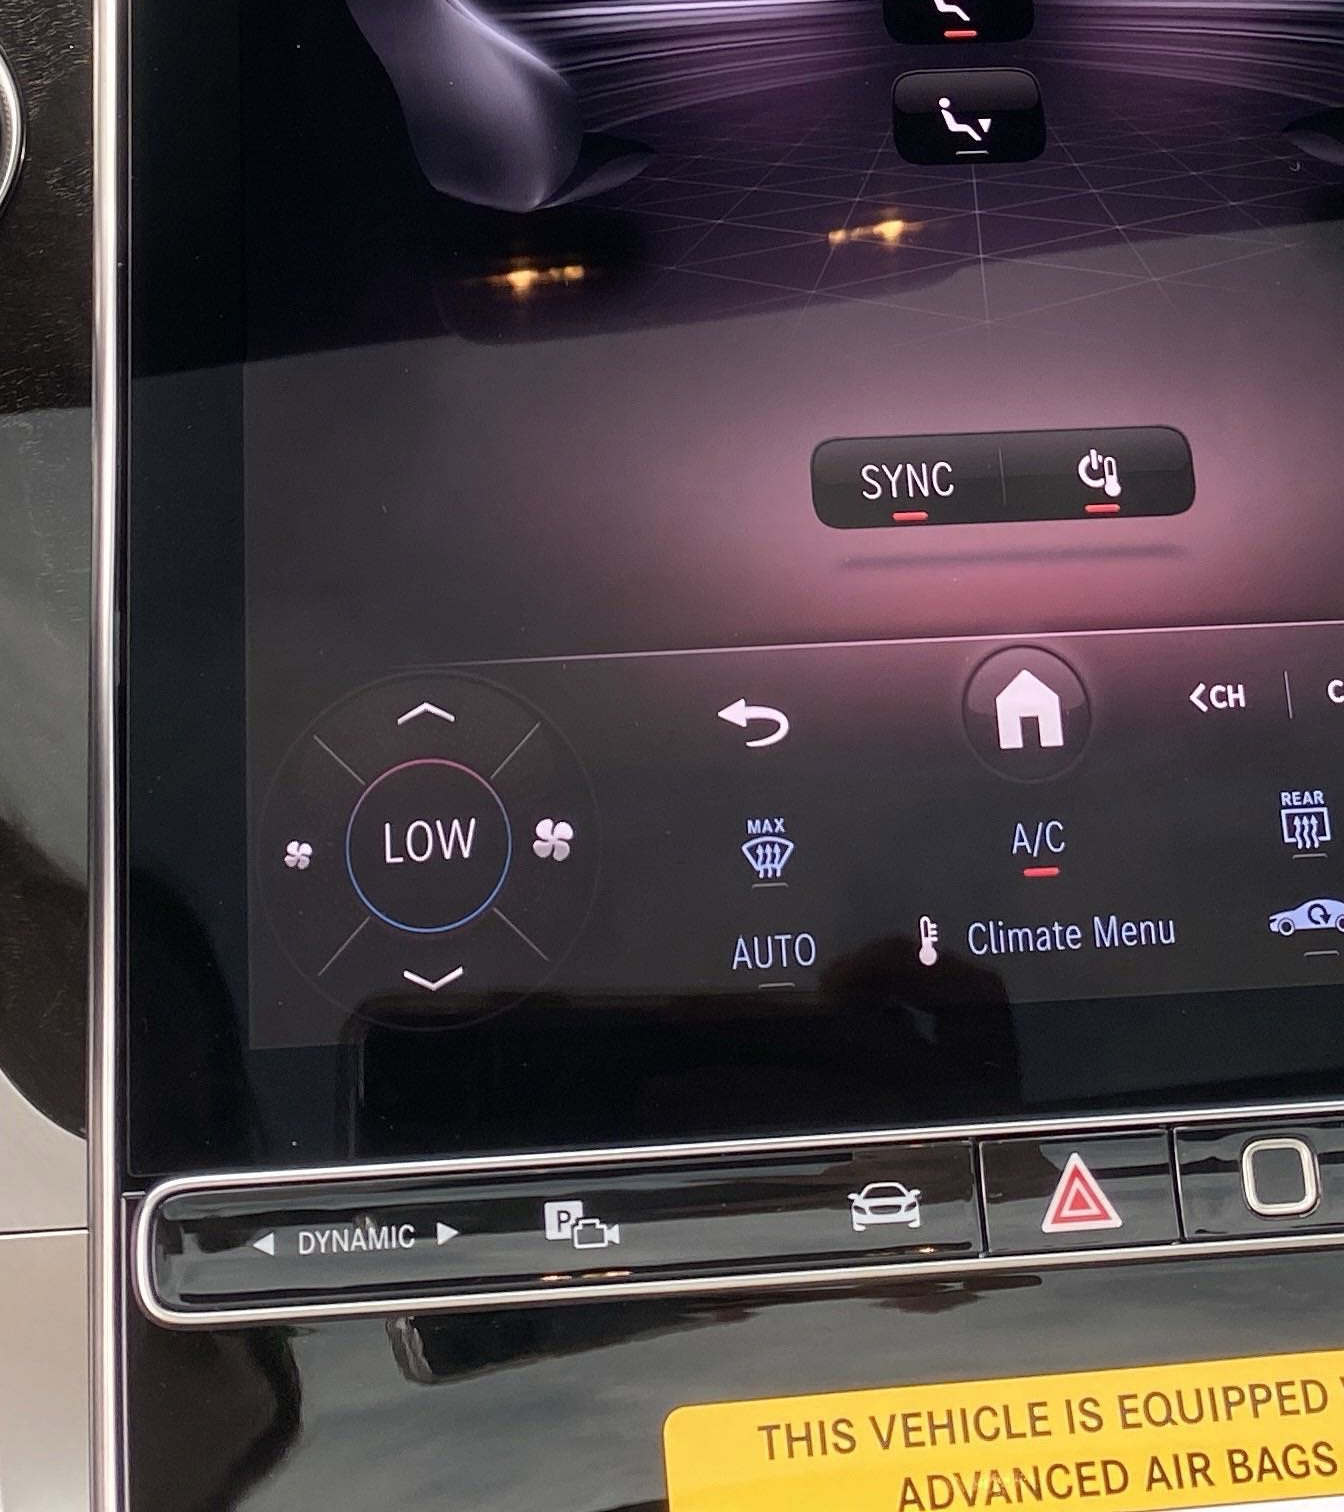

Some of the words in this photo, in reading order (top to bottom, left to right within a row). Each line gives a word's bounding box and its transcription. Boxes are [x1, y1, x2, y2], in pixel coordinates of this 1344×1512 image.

[861, 461, 954, 500] SYNC
[1280, 790, 1325, 807] REAR
[383, 817, 476, 864] LOW
[747, 819, 786, 834] MAX
[1012, 820, 1066, 857] A/C
[732, 933, 817, 970] AUTO
[968, 915, 1082, 955] Climate
[1093, 915, 1176, 949] Menu
[298, 1224, 416, 1255] DYNAMIC
[757, 1418, 857, 1460] THIS
[869, 1401, 1052, 1450] VEHICLE
[1065, 1397, 1104, 1434] IS
[1117, 1379, 1330, 1430] EQUIPPED
[898, 1459, 1130, 1512] ADVANCED
[1145, 1451, 1215, 1492] AIR
[1227, 1440, 1339, 1484] BAGS
